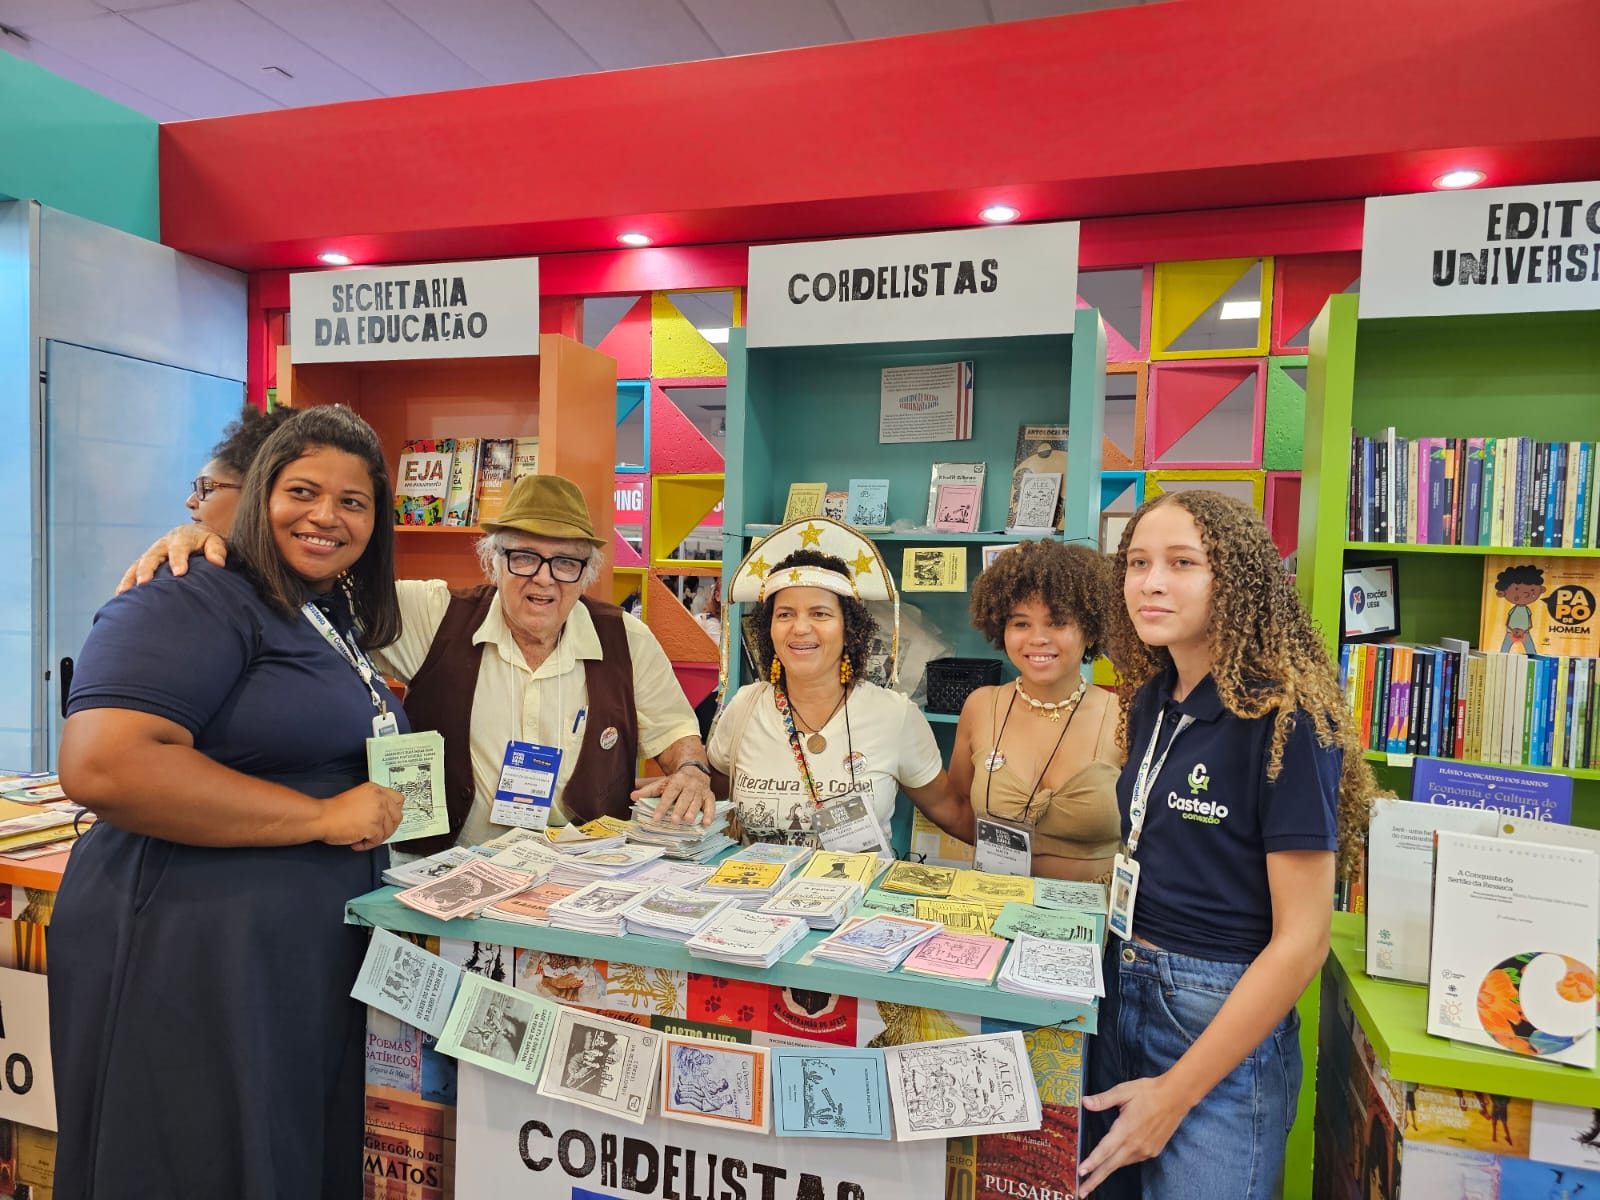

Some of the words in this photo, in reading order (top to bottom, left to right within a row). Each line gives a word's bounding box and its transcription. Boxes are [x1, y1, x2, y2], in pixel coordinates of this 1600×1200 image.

[788, 258, 999, 305] CORDELISTAS
[332, 277, 468, 313] SECRETARIA
[314, 316, 350, 347] DA
[357, 311, 489, 345] EDUCAÇÃO
[403, 460, 443, 481] EJA
[1548, 625, 1590, 634] HOMEM
[1428, 782, 1482, 798] Economia
[1494, 791, 1539, 806] Cultura
[1541, 798, 1557, 808] do
[1521, 779, 1549, 788] SANTOS
[1167, 791, 1229, 818] Castelo
[1448, 876, 1471, 887] Sertão
[1464, 870, 1502, 883] Conquista
[369, 1034, 412, 1053] POEMAS
[366, 1046, 418, 1068] SATÍRICOS
[0, 1053, 33, 1096] O
[997, 1058, 1014, 1102] ALICE
[365, 1136, 424, 1160] GREGÓRIO
[428, 1152, 443, 1163] DE
[1022, 1134, 1051, 1148] Almeida
[364, 1154, 438, 1188] MATOS
